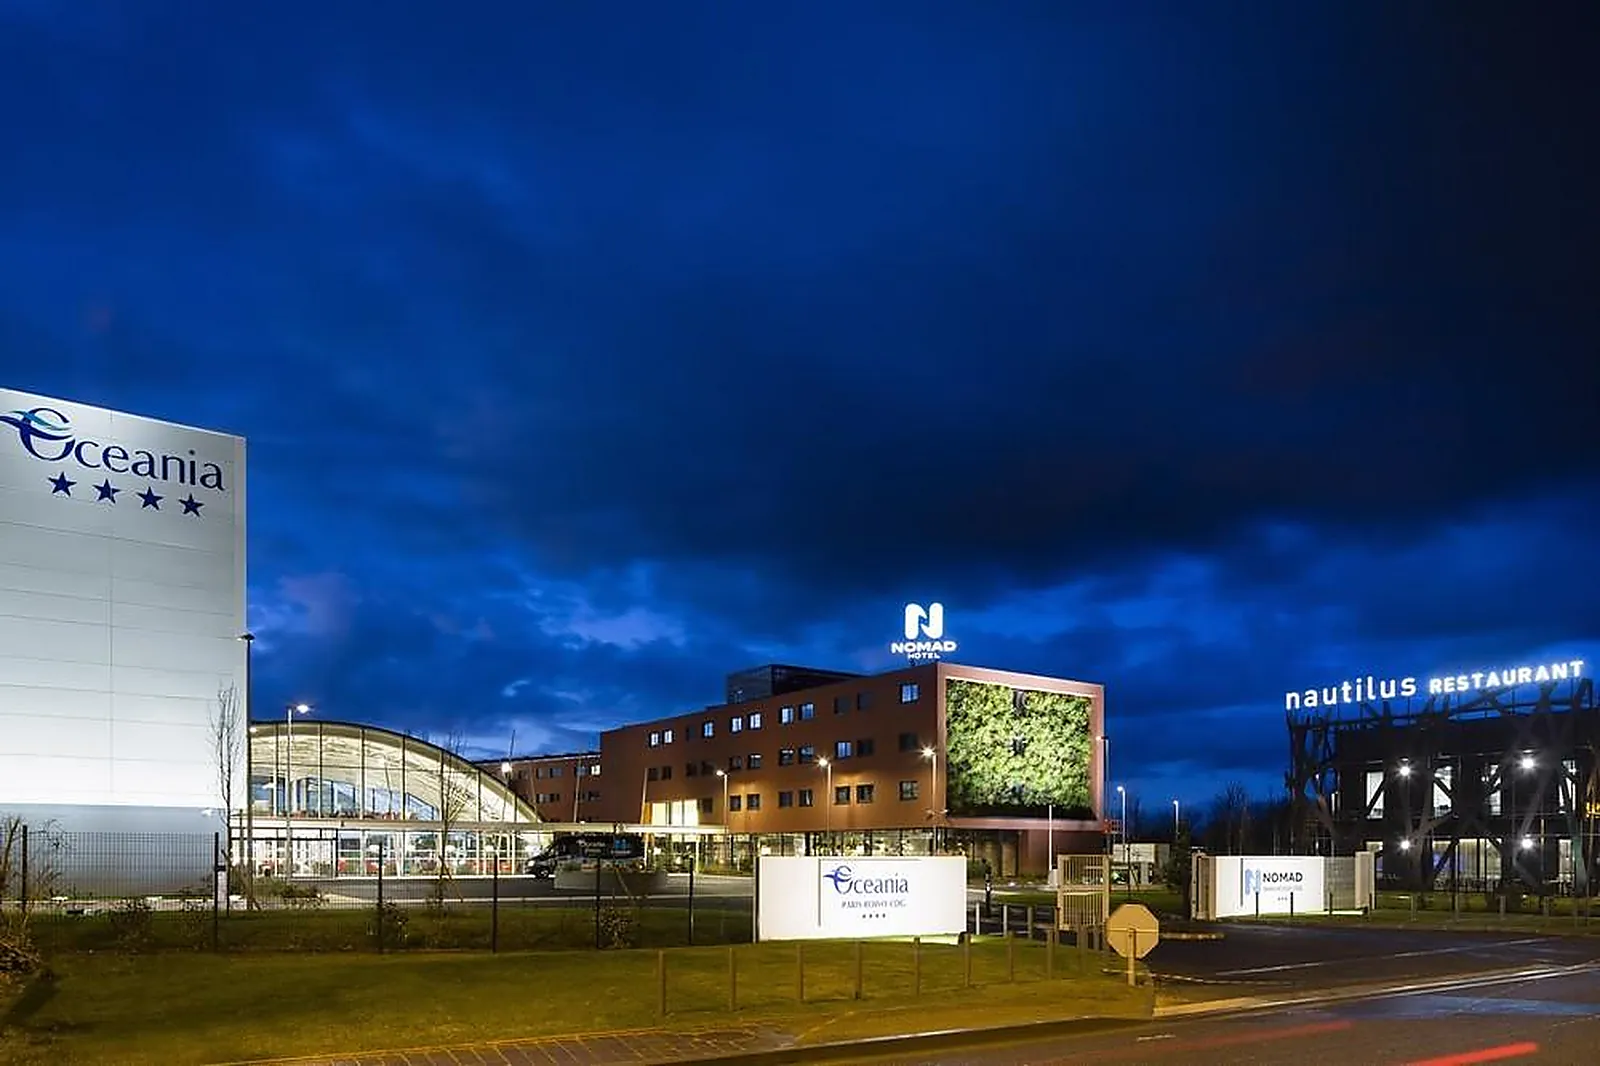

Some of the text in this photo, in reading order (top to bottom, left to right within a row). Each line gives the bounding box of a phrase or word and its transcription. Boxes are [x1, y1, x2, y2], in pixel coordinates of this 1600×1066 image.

[8, 407, 224, 491] Oceania
[905, 602, 943, 640] N
[891, 641, 957, 653] NOMAD
[1286, 660, 1584, 710] nautilus RESTAURANT
[828, 865, 908, 895] Oceania
[1263, 872, 1303, 882] NOMAD
